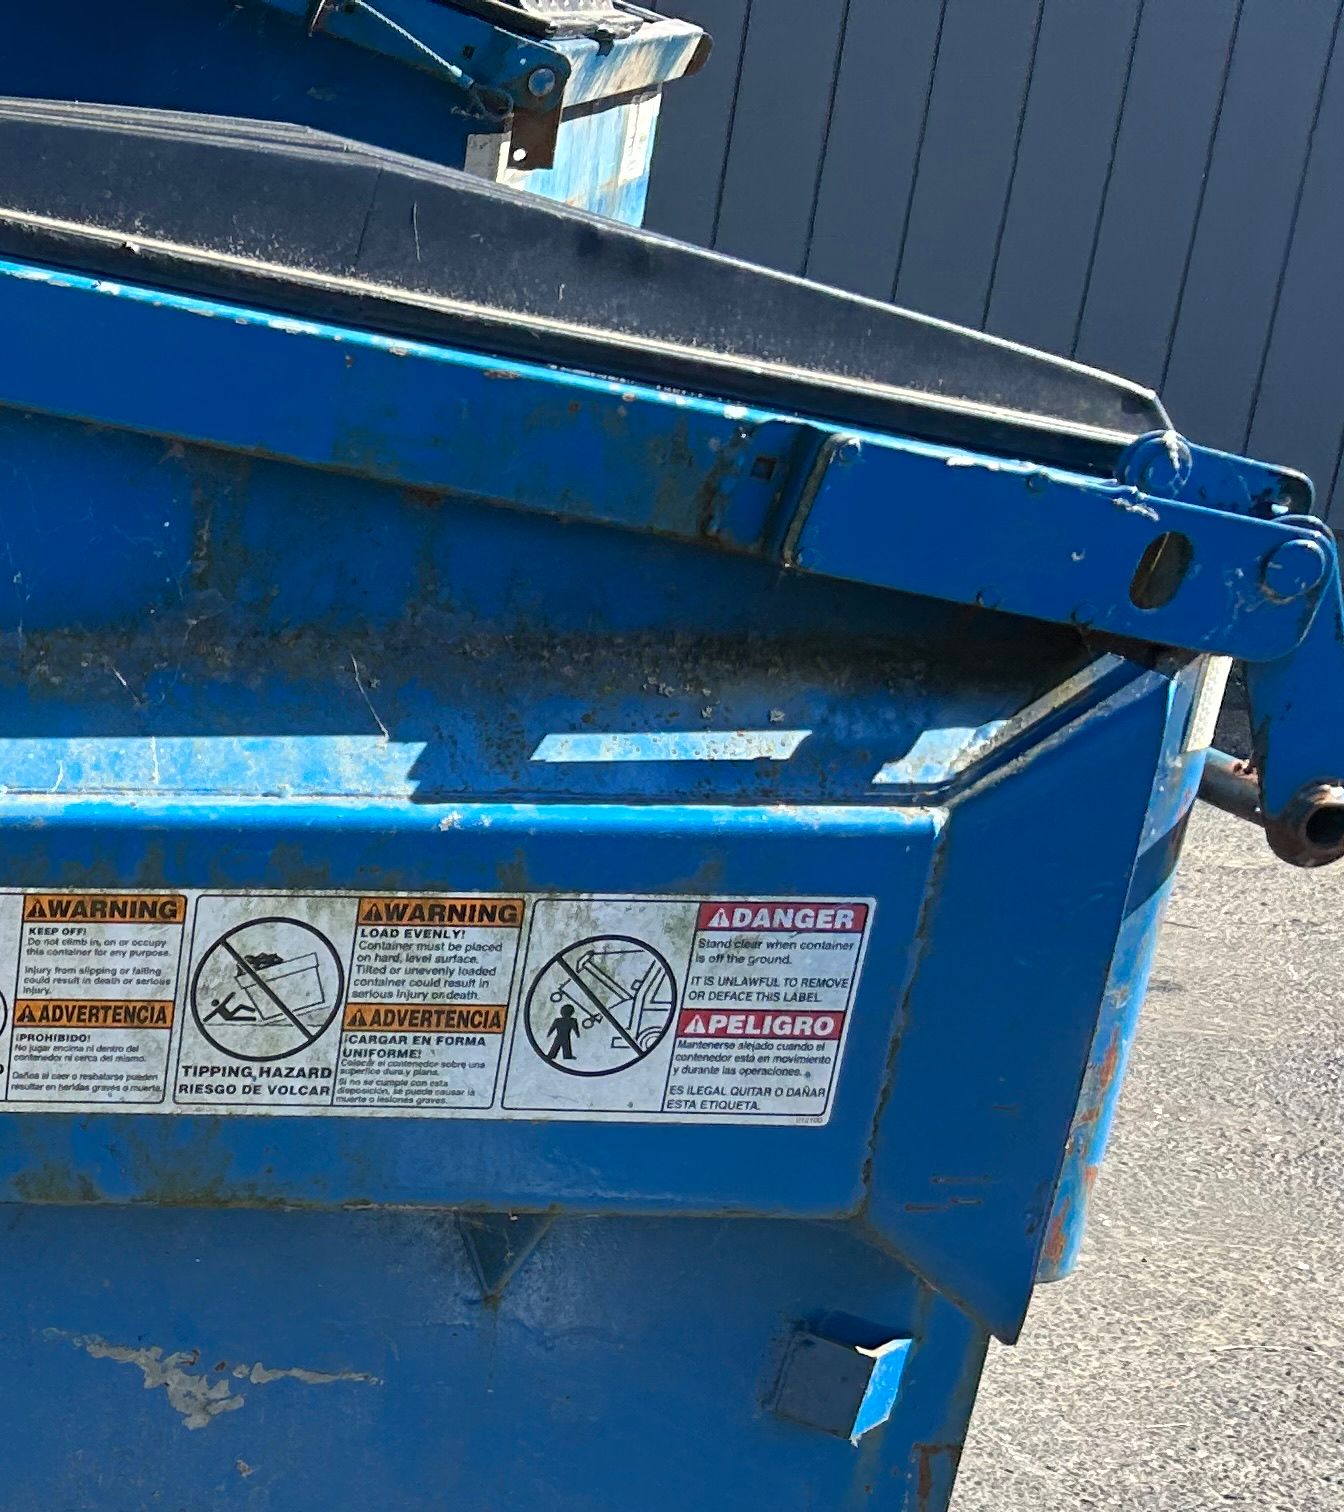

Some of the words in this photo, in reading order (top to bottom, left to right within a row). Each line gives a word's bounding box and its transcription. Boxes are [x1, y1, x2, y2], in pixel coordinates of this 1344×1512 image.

[49, 900, 176, 919] WARNING
[384, 903, 517, 923] WARNING
[732, 908, 854, 929] DANGER
[361, 928, 399, 938] LOAD
[404, 929, 465, 939] EVENLY!
[28, 938, 40, 946] Do
[132, 940, 166, 948] occupy
[359, 941, 412, 950] Container
[417, 942, 444, 951] must
[448, 942, 462, 951] be
[465, 942, 502, 952] placed
[698, 939, 732, 949] Stand
[734, 939, 762, 949] clear
[766, 941, 796, 950] when
[800, 941, 854, 950] container
[110, 949, 126, 957] any
[406, 954, 432, 963] level
[696, 954, 705, 962] is
[709, 954, 724, 963] off
[727, 954, 745, 963] the
[748, 955, 792, 966] ground.
[79, 967, 116, 976] slipping
[356, 965, 386, 974] Tilted
[390, 967, 401, 975] or
[404, 966, 455, 977] unevenly
[458, 967, 496, 976] loaded
[354, 978, 406, 986] container
[409, 978, 441, 987] could
[444, 978, 475, 987] result
[479, 979, 489, 988] in
[691, 976, 702, 985] IT
[704, 977, 713, 986] IS
[718, 977, 780, 986] UNLAWFUL
[784, 978, 798, 987] TO
[801, 978, 849, 988] REMOVE
[351, 989, 393, 999] serious
[396, 989, 428, 1000] injury
[432, 991, 443, 999] or
[688, 990, 706, 1000] OR
[709, 991, 752, 1000] DEFACE
[756, 992, 780, 1001] THIS
[38, 1005, 166, 1024] ADVERTENCIA
[370, 1009, 501, 1029] ADVERTENCIA
[708, 1015, 834, 1036] PELIGRO
[678, 1040, 735, 1050] Mantenerse
[738, 1042, 774, 1052] alejado
[777, 1043, 814, 1051] cuando
[816, 1043, 825, 1051] el
[675, 1054, 732, 1062] contenedor
[773, 1055, 831, 1064] movimiento
[182, 1066, 252, 1077] TIPPING
[259, 1067, 332, 1079] HAZARD
[682, 1066, 720, 1074] durante
[722, 1067, 736, 1075] las
[739, 1068, 802, 1077] operaciones.
[179, 1084, 237, 1094] RIESGO
[242, 1085, 262, 1095] DE
[268, 1086, 330, 1095] VOLCAR
[670, 1086, 684, 1095] ES
[687, 1086, 726, 1095] ILEGAL
[730, 1087, 771, 1097] QUITAR
[775, 1088, 783, 1096] O
[786, 1086, 826, 1097] DAÑAR
[667, 1100, 696, 1110] ESTA
[700, 1101, 760, 1110] ETIQUETA.
